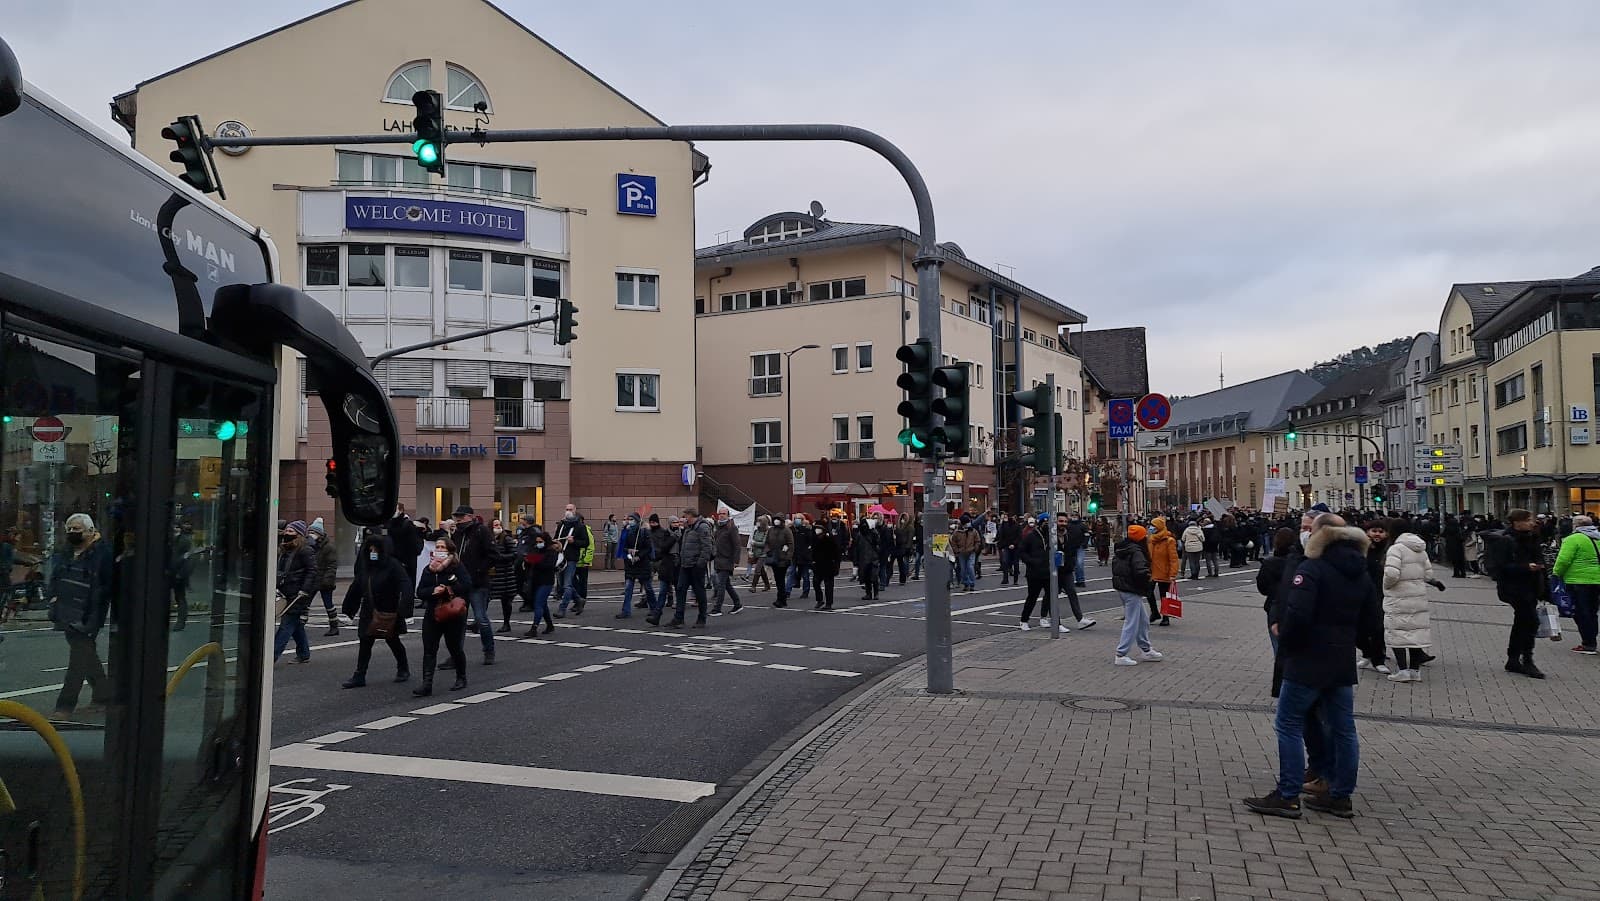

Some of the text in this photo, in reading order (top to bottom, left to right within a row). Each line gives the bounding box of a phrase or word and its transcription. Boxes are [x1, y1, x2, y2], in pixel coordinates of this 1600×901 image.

[353, 205, 518, 231] WELCOME HOTEL
[186, 229, 235, 273] MAN
[1111, 424, 1132, 435] TAXI
[401, 442, 488, 458] tsche Bank
